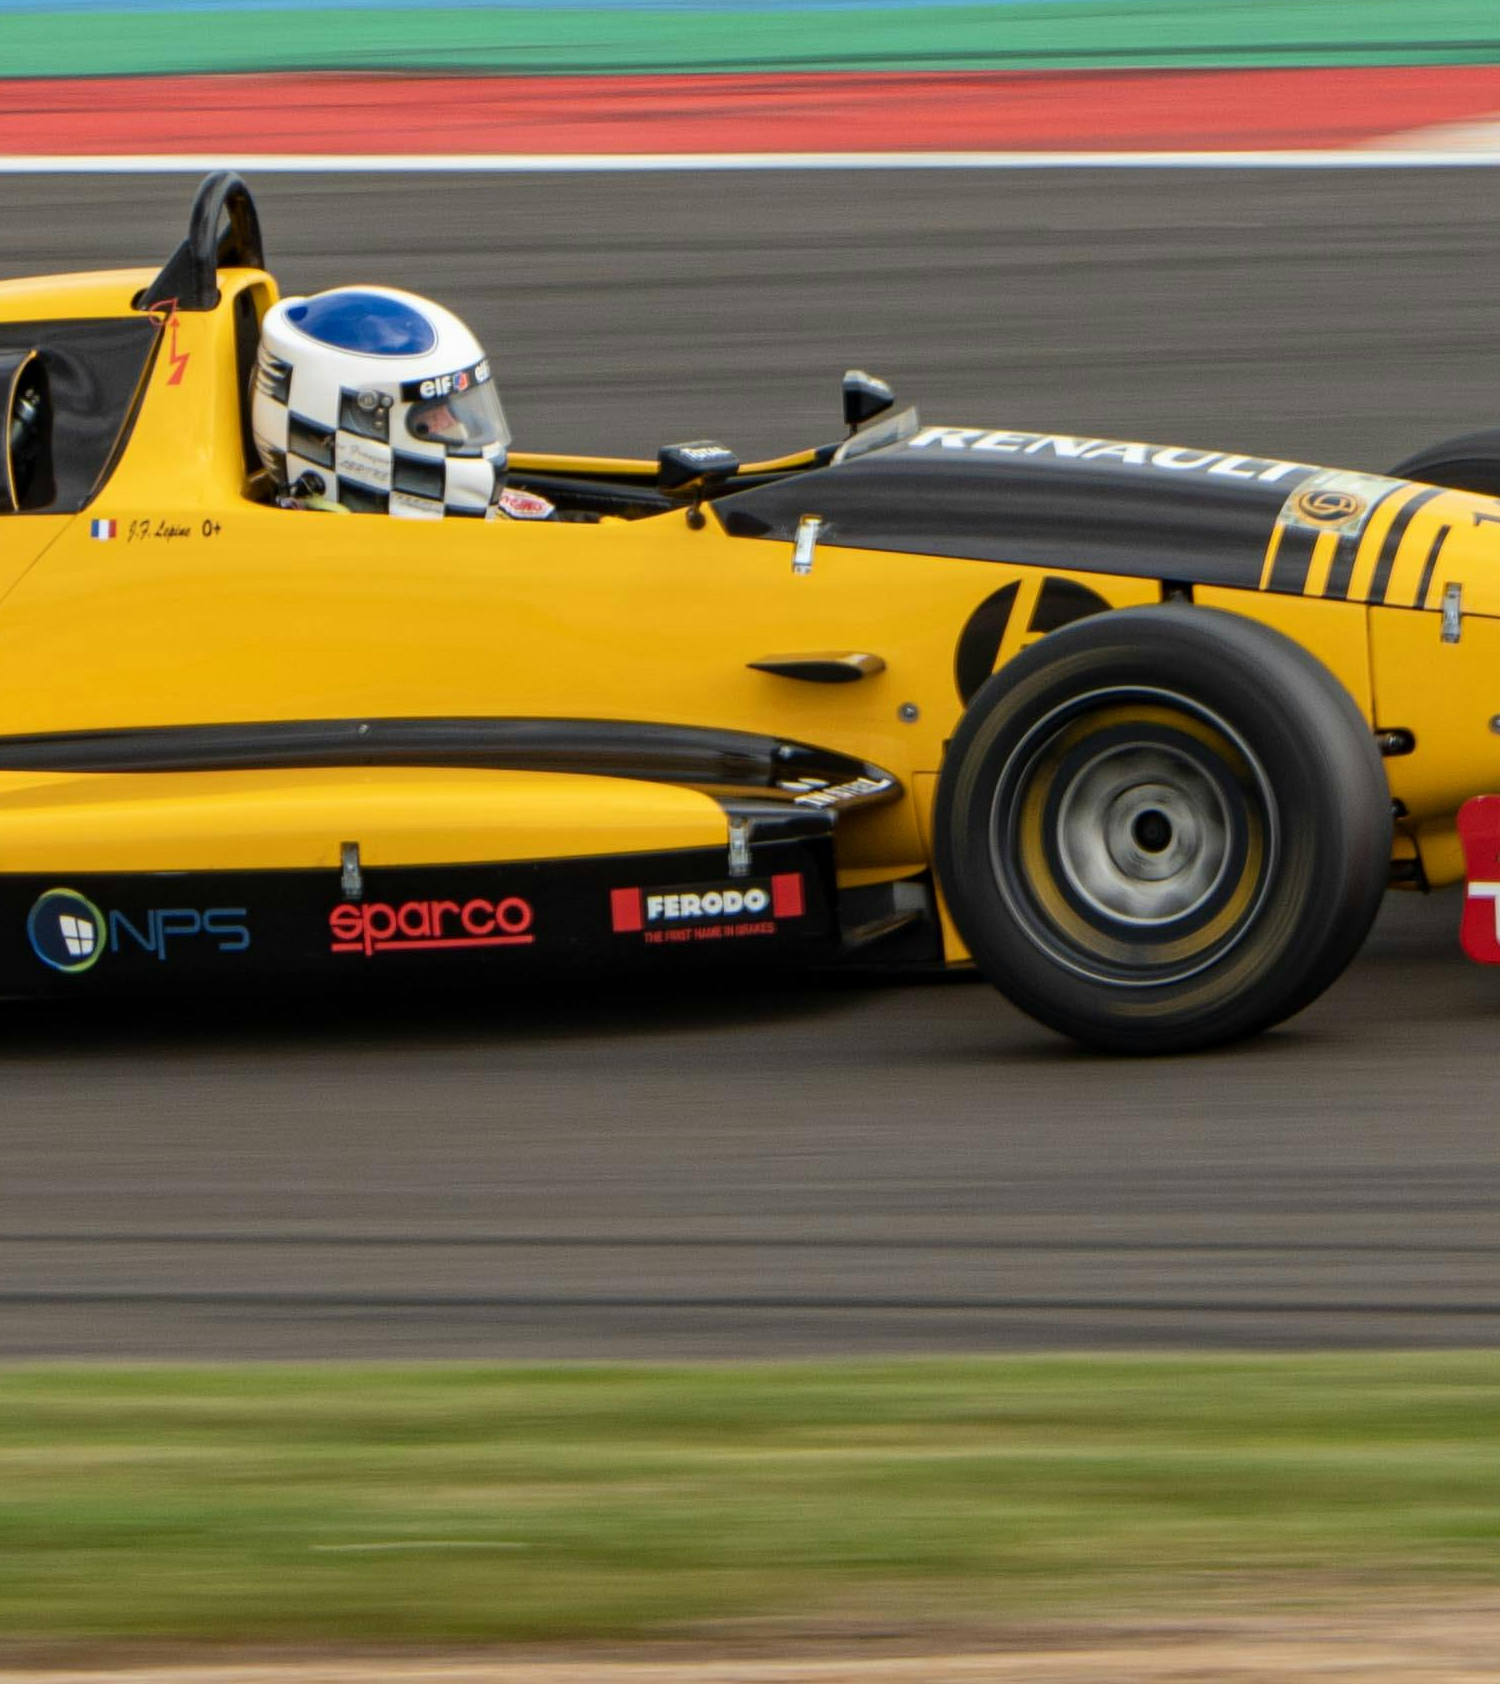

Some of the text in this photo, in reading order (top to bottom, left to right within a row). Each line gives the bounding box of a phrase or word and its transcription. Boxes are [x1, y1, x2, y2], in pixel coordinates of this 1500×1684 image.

[908, 426, 1315, 483] RENAULT
[329, 897, 532, 956] sparco
[647, 887, 769, 920] FERODO
[109, 908, 250, 961] NPS
